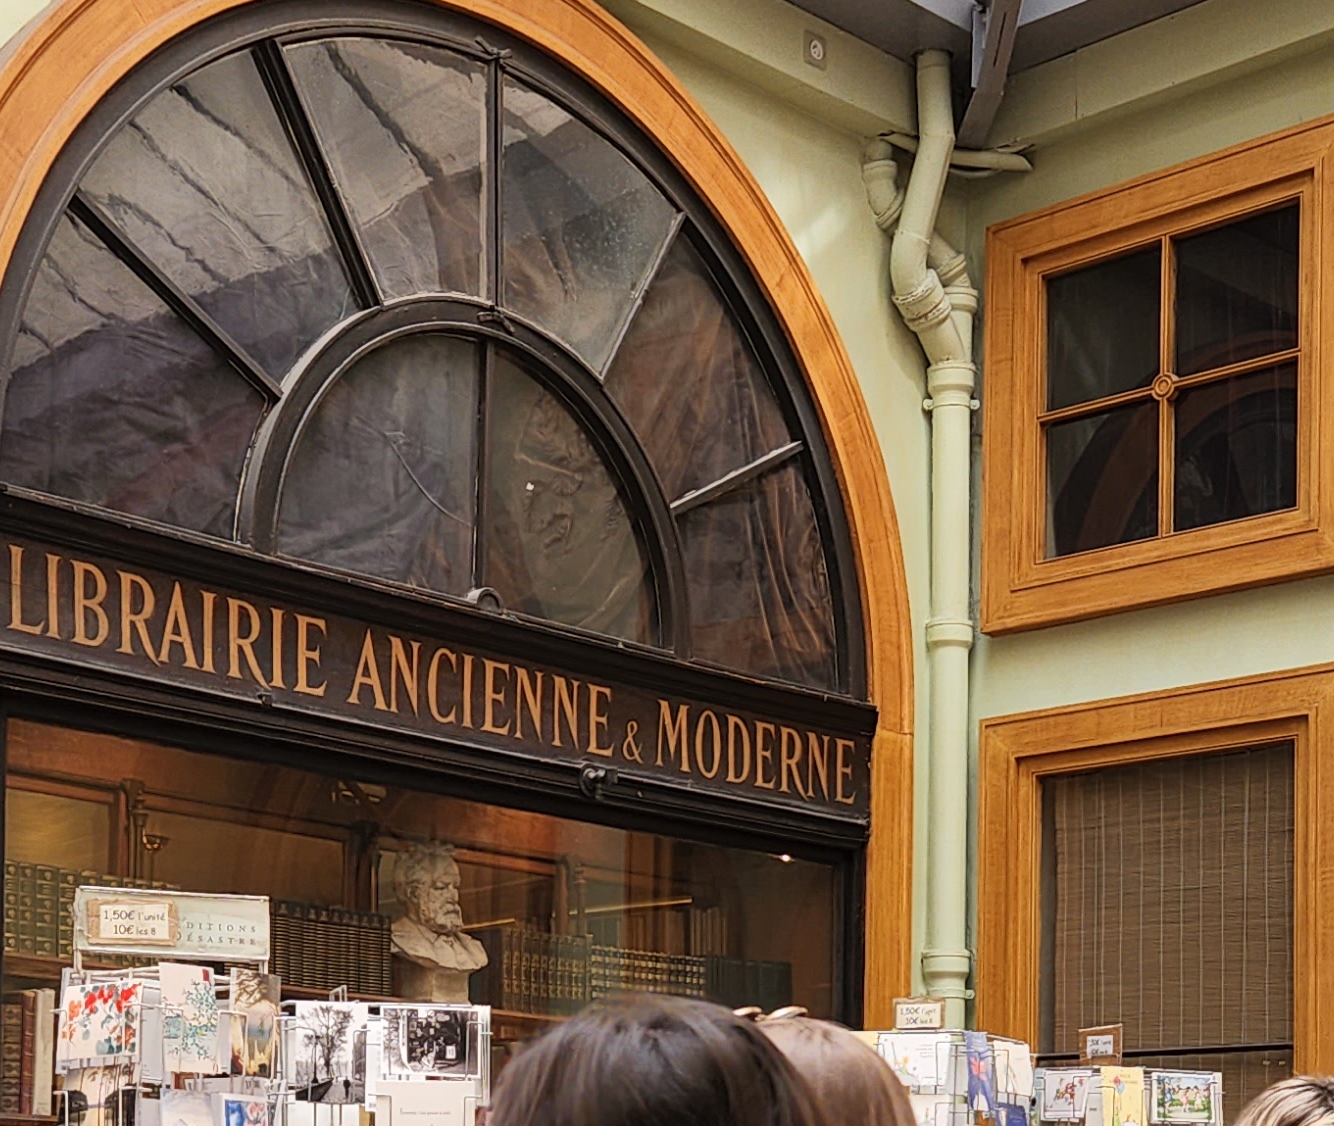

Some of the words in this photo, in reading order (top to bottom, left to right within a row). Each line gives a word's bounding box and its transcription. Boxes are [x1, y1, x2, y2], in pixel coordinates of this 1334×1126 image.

[6, 544, 329, 697] LIBRAIRIE
[346, 628, 615, 757] ANCIENNE
[622, 720, 643, 763] &
[655, 699, 858, 805] MODERNE
[104, 910, 135, 921] 1,50€
[138, 911, 166, 922] l'unité
[113, 924, 134, 935] 10€
[136, 926, 150, 935] les
[151, 927, 156, 936] 8
[183, 919, 257, 933] DITIONS
